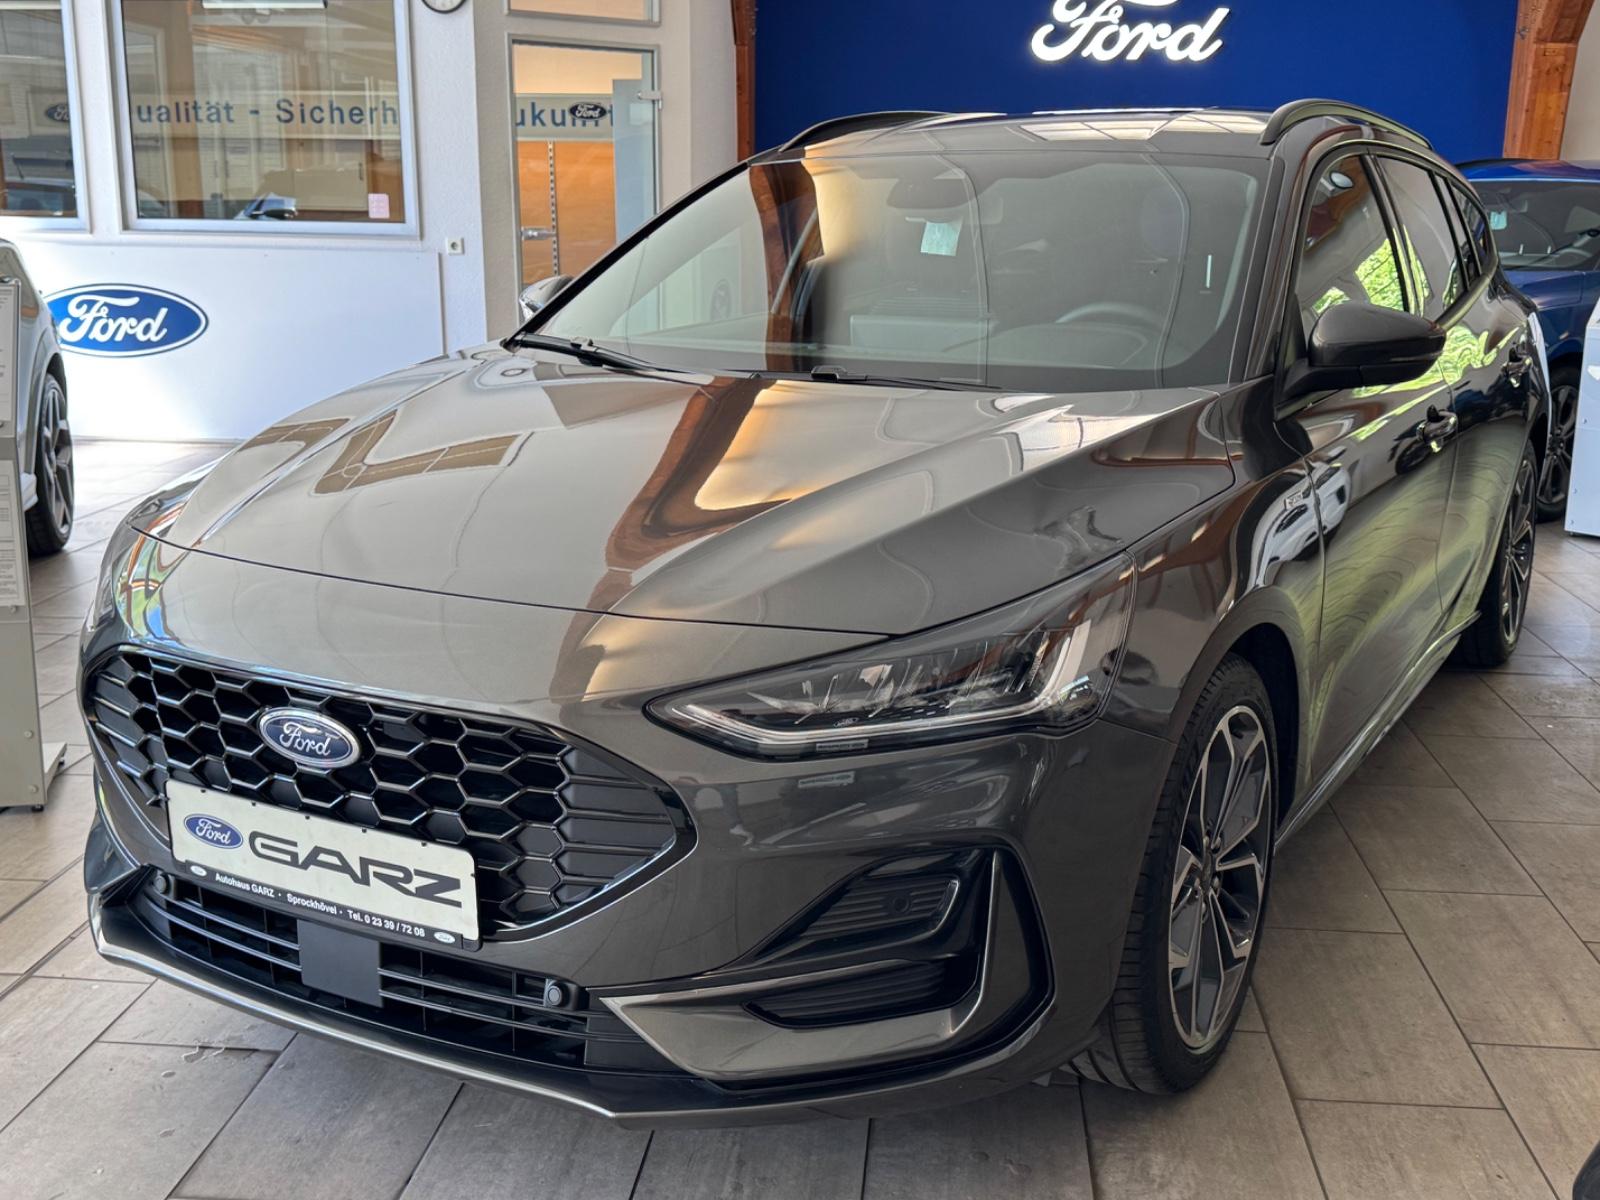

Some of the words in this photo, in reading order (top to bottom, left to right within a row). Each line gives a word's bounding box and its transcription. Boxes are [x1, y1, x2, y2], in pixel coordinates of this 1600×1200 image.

[1031, 0, 1230, 62] Ford
[135, 99, 234, 124] ualität
[276, 98, 398, 125] Sicherh
[59, 294, 168, 343] Ford
[279, 721, 332, 758] Ford
[195, 818, 232, 845] Ford
[249, 830, 462, 908] GARZ
[215, 872, 251, 891] Autohaus
[251, 883, 275, 898] GARZ
[287, 893, 337, 915] Sprockhövel
[347, 908, 363, 922] Tel.
[371, 916, 383, 928] 23
[384, 919, 395, 931] 39
[401, 923, 413, 934] 72
